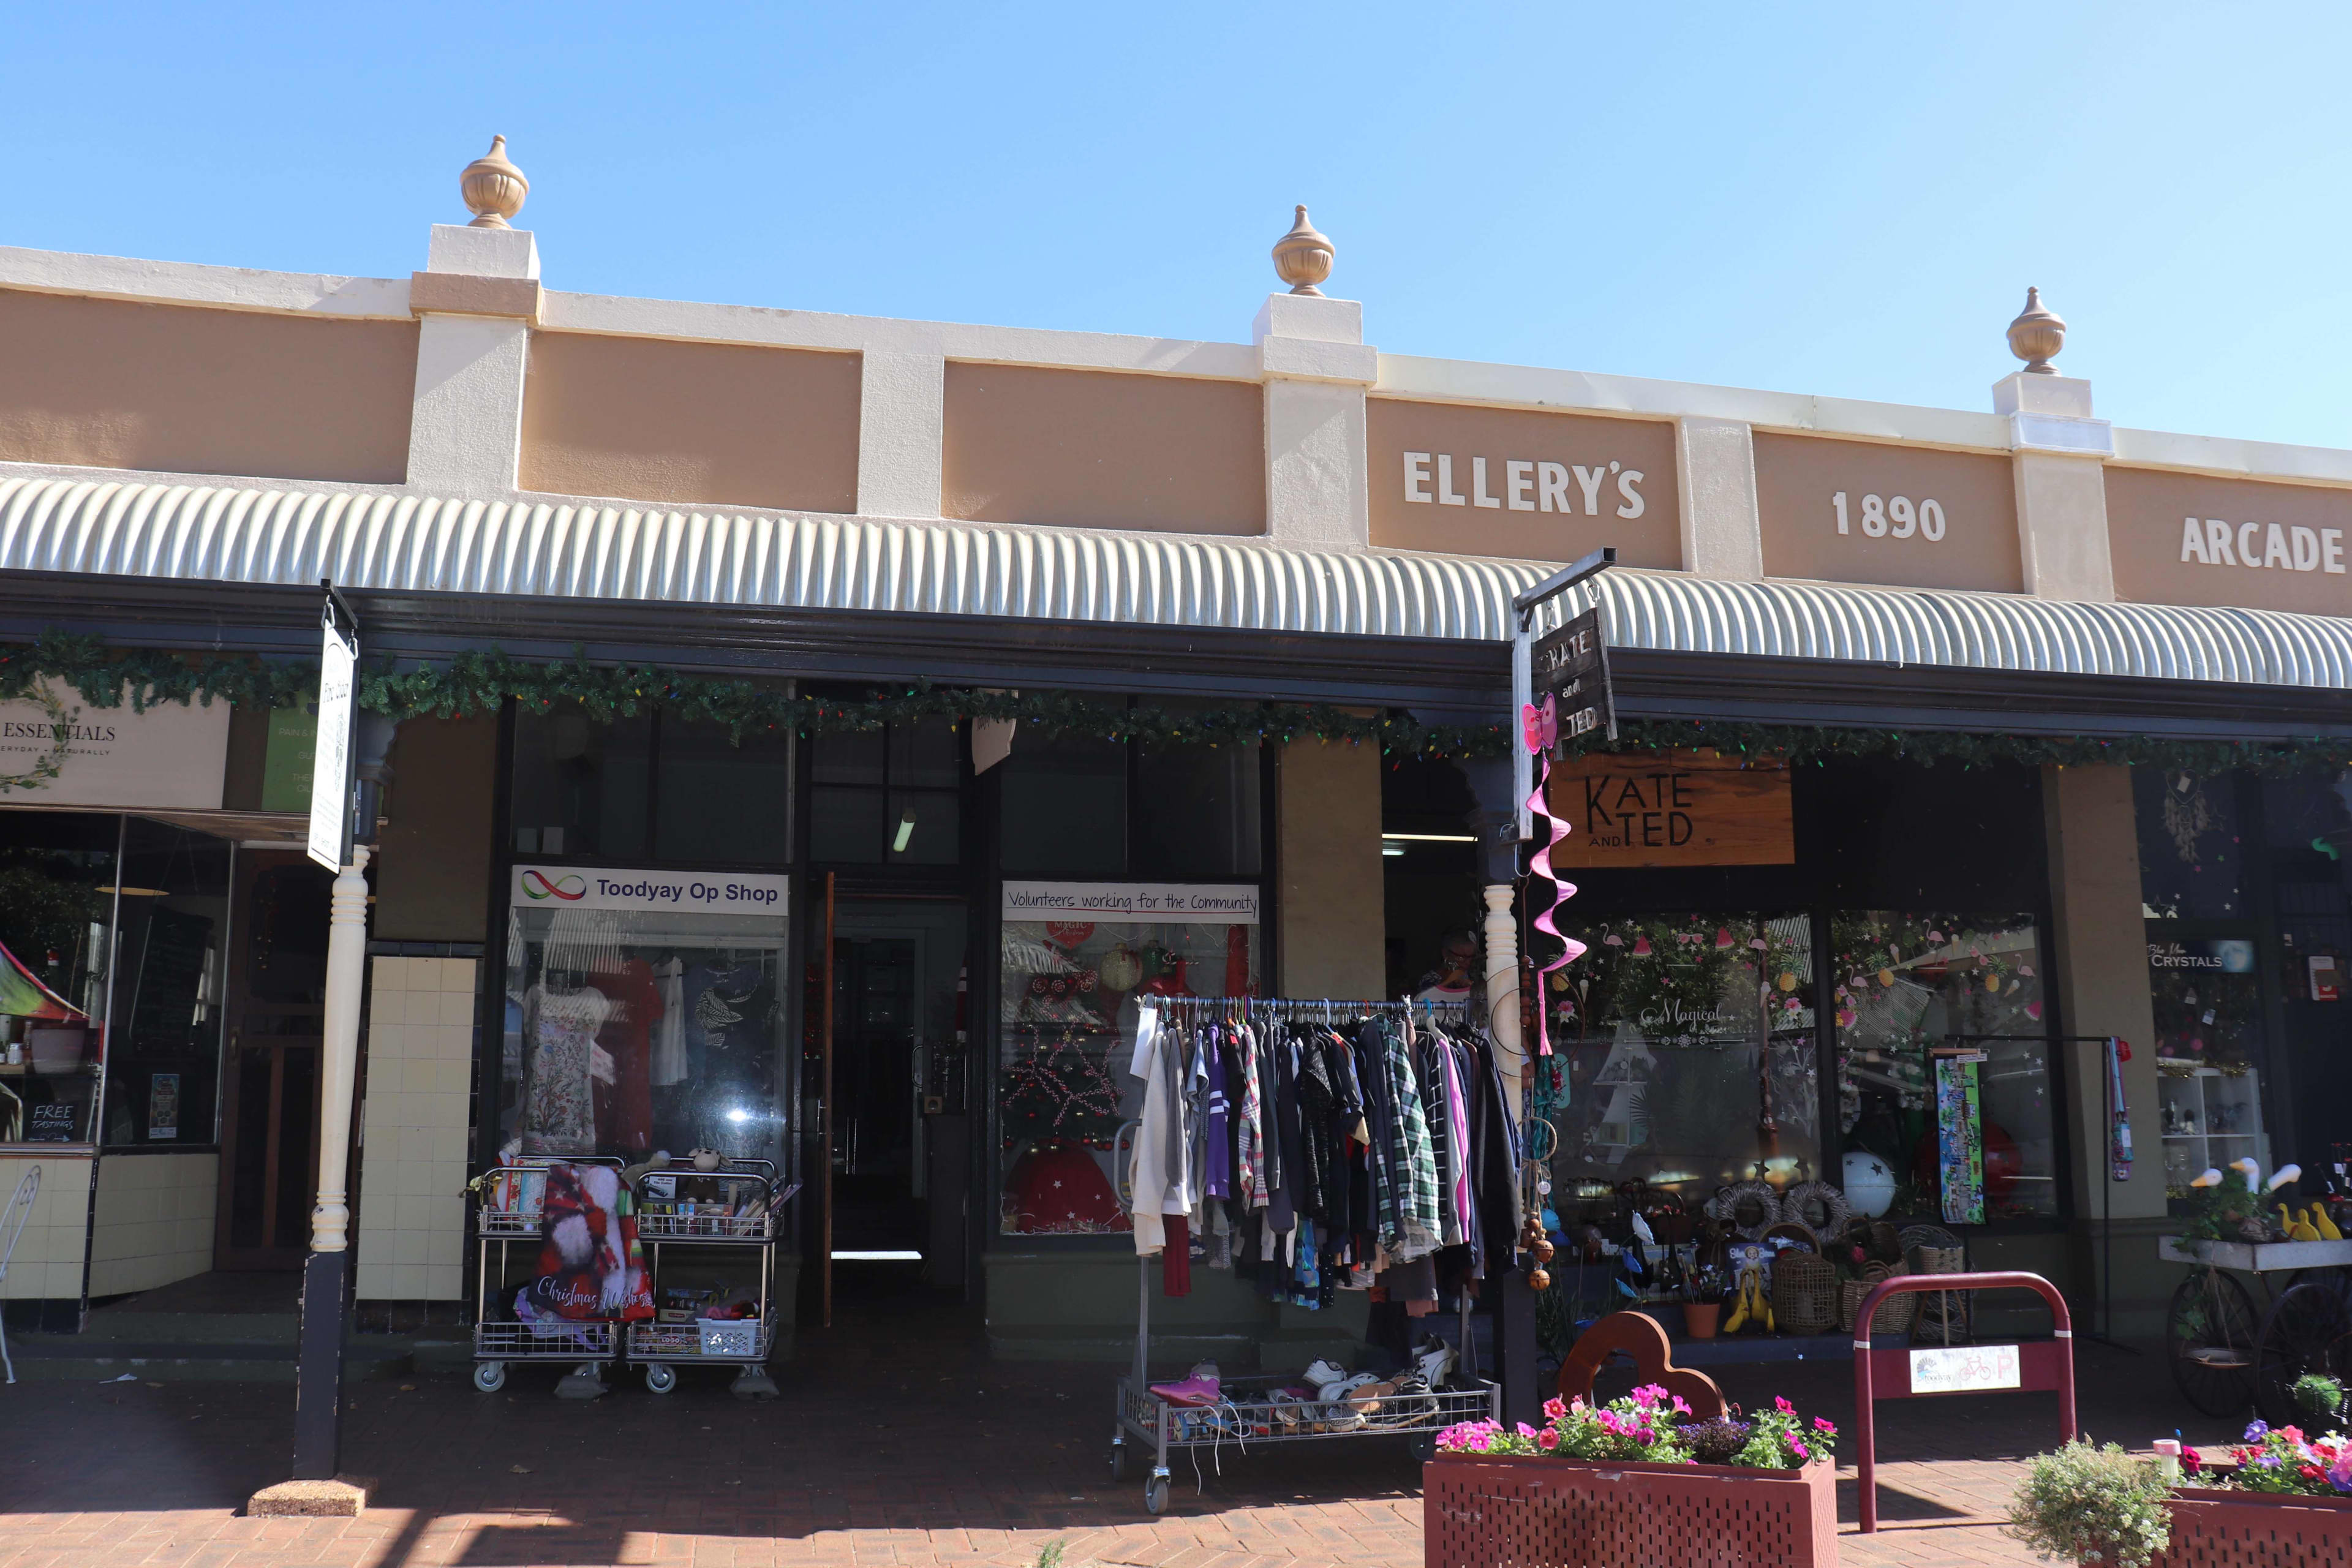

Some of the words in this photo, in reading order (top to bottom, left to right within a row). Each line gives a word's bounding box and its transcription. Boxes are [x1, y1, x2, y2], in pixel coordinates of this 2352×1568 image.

[1403, 451, 1646, 519] ELLERY'S
[1833, 491, 1946, 542] 1890
[2180, 517, 2346, 574] ARCADE
[1548, 630, 1593, 671] KATE
[1562, 678, 1581, 698] and
[4, 722, 115, 741] ESSENTIALS
[1566, 706, 1598, 737] TED
[1585, 773, 1692, 834] KATE
[1588, 835, 1621, 847] AND
[1615, 811, 1693, 847] TED
[597, 879, 684, 902] Toodyay
[690, 883, 719, 903] Op
[725, 884, 778, 905] Shop
[1008, 891, 1076, 907] Volunteers
[1082, 892, 1133, 914] working
[1136, 892, 1160, 909] for
[1164, 893, 1185, 909] the
[1190, 894, 1257, 918] Community
[2151, 954, 2223, 967] CRYSTALS
[1640, 998, 1722, 1033] Magical
[31, 1120, 74, 1131] TASTINGS
[33, 1104, 74, 1119] FREE
[537, 1275, 598, 1310] Christmas
[601, 1286, 646, 1310] Wishes
[1997, 1354, 2015, 1379] P
